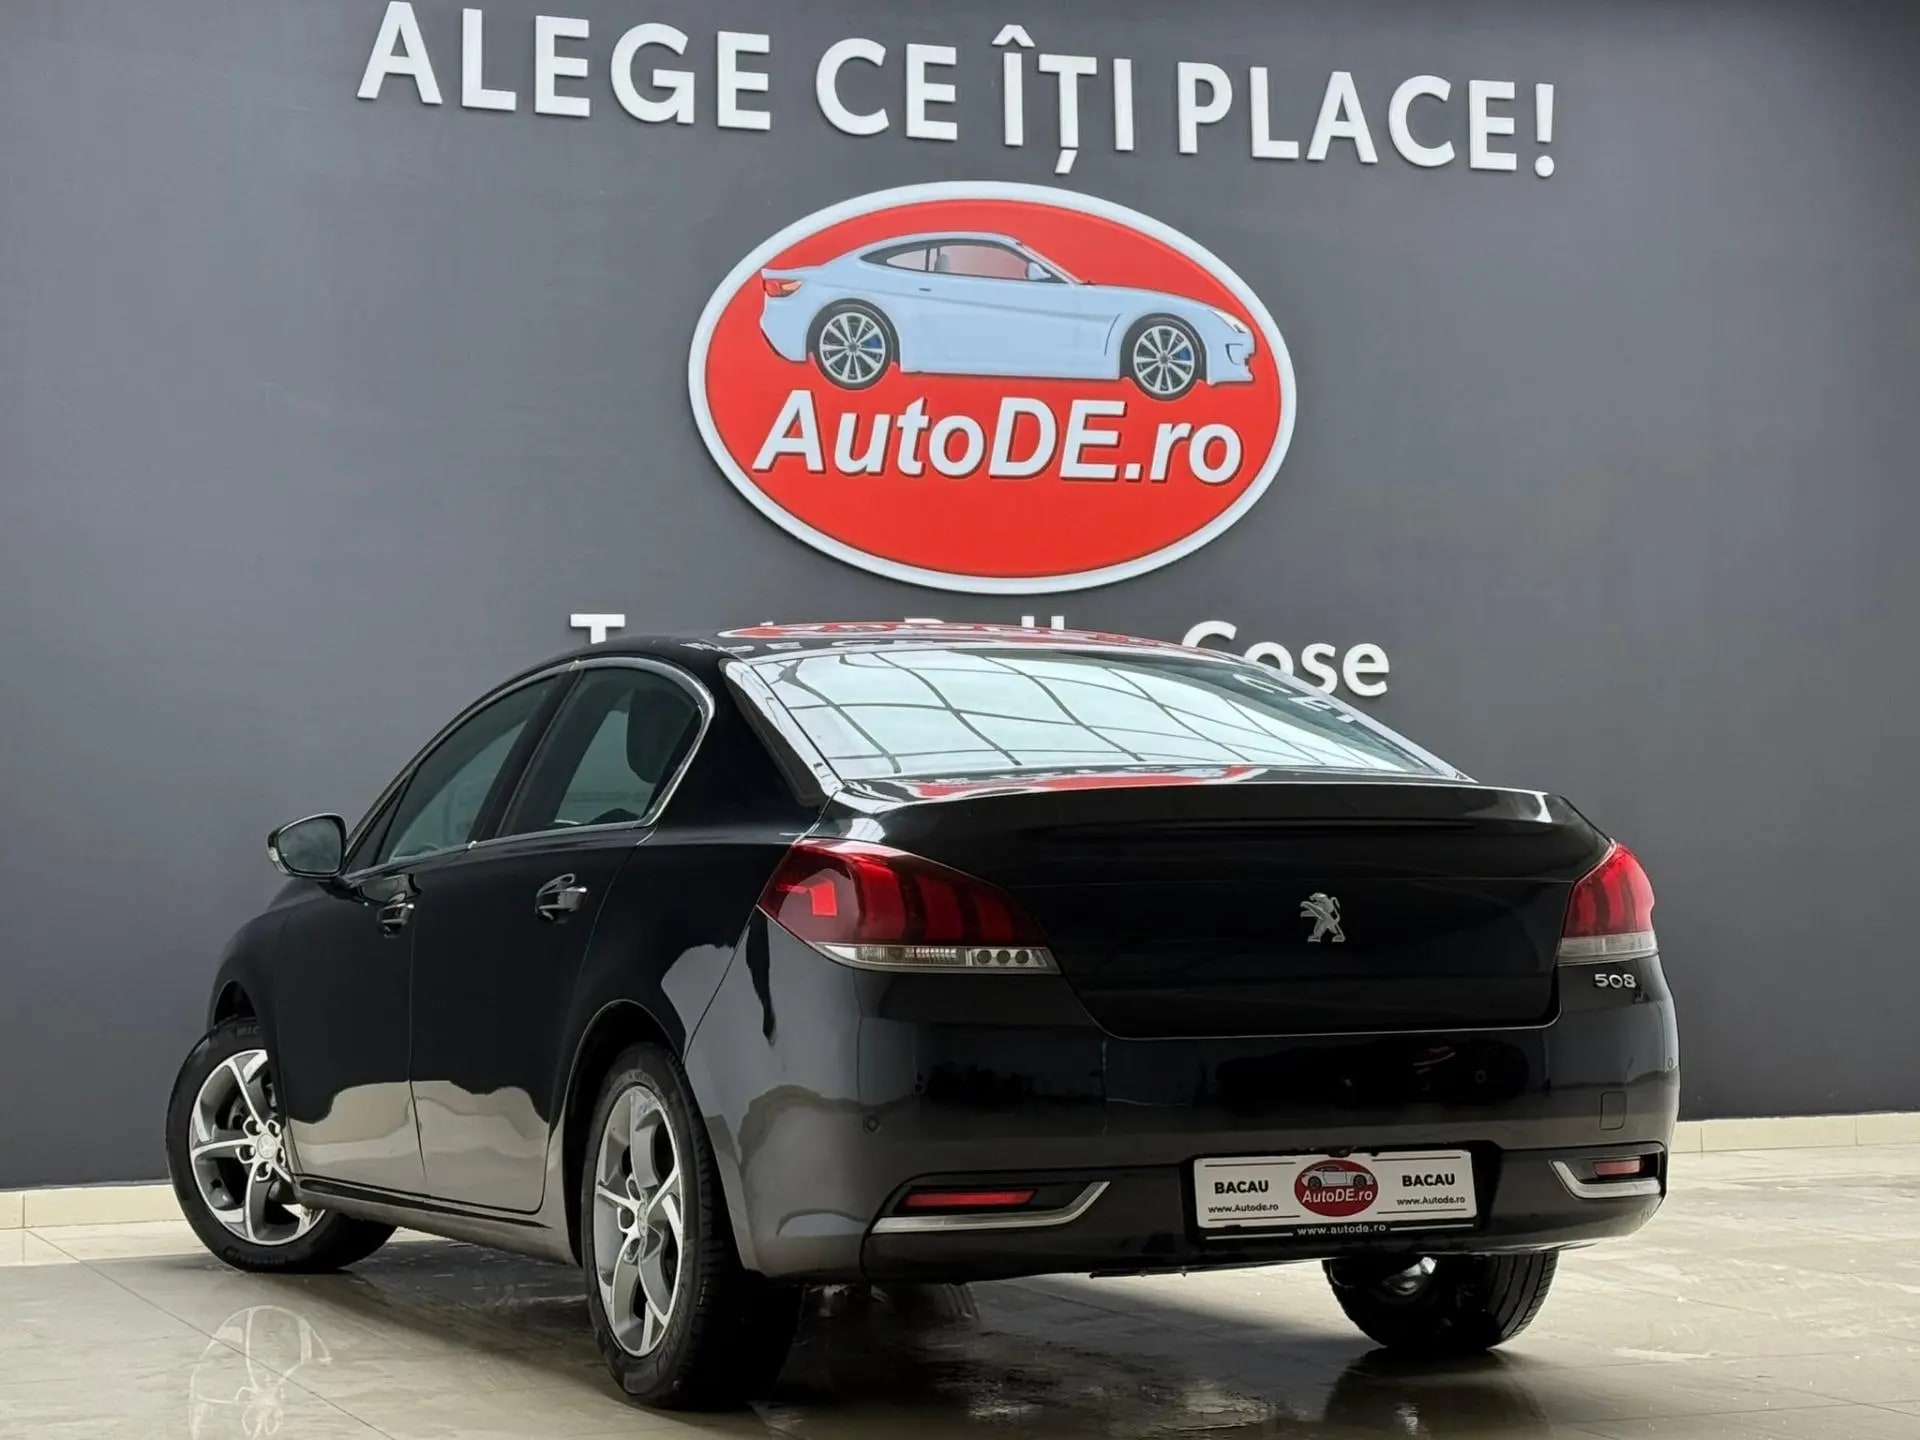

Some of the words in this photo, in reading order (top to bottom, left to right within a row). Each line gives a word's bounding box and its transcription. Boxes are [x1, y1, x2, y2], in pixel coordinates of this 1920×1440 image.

[357, 1, 771, 131] ALEGE
[816, 38, 958, 141] CE
[1177, 61, 1555, 178] PLACE!
[752, 389, 1243, 484] AutoDE.ro
[1594, 974, 1636, 988] 508
[1214, 1180, 1269, 1194] BACAU
[1402, 1173, 1455, 1187] BACAU
[1302, 1188, 1373, 1203] AutoDE.ro
[1297, 1224, 1386, 1235] www.autode.ro
